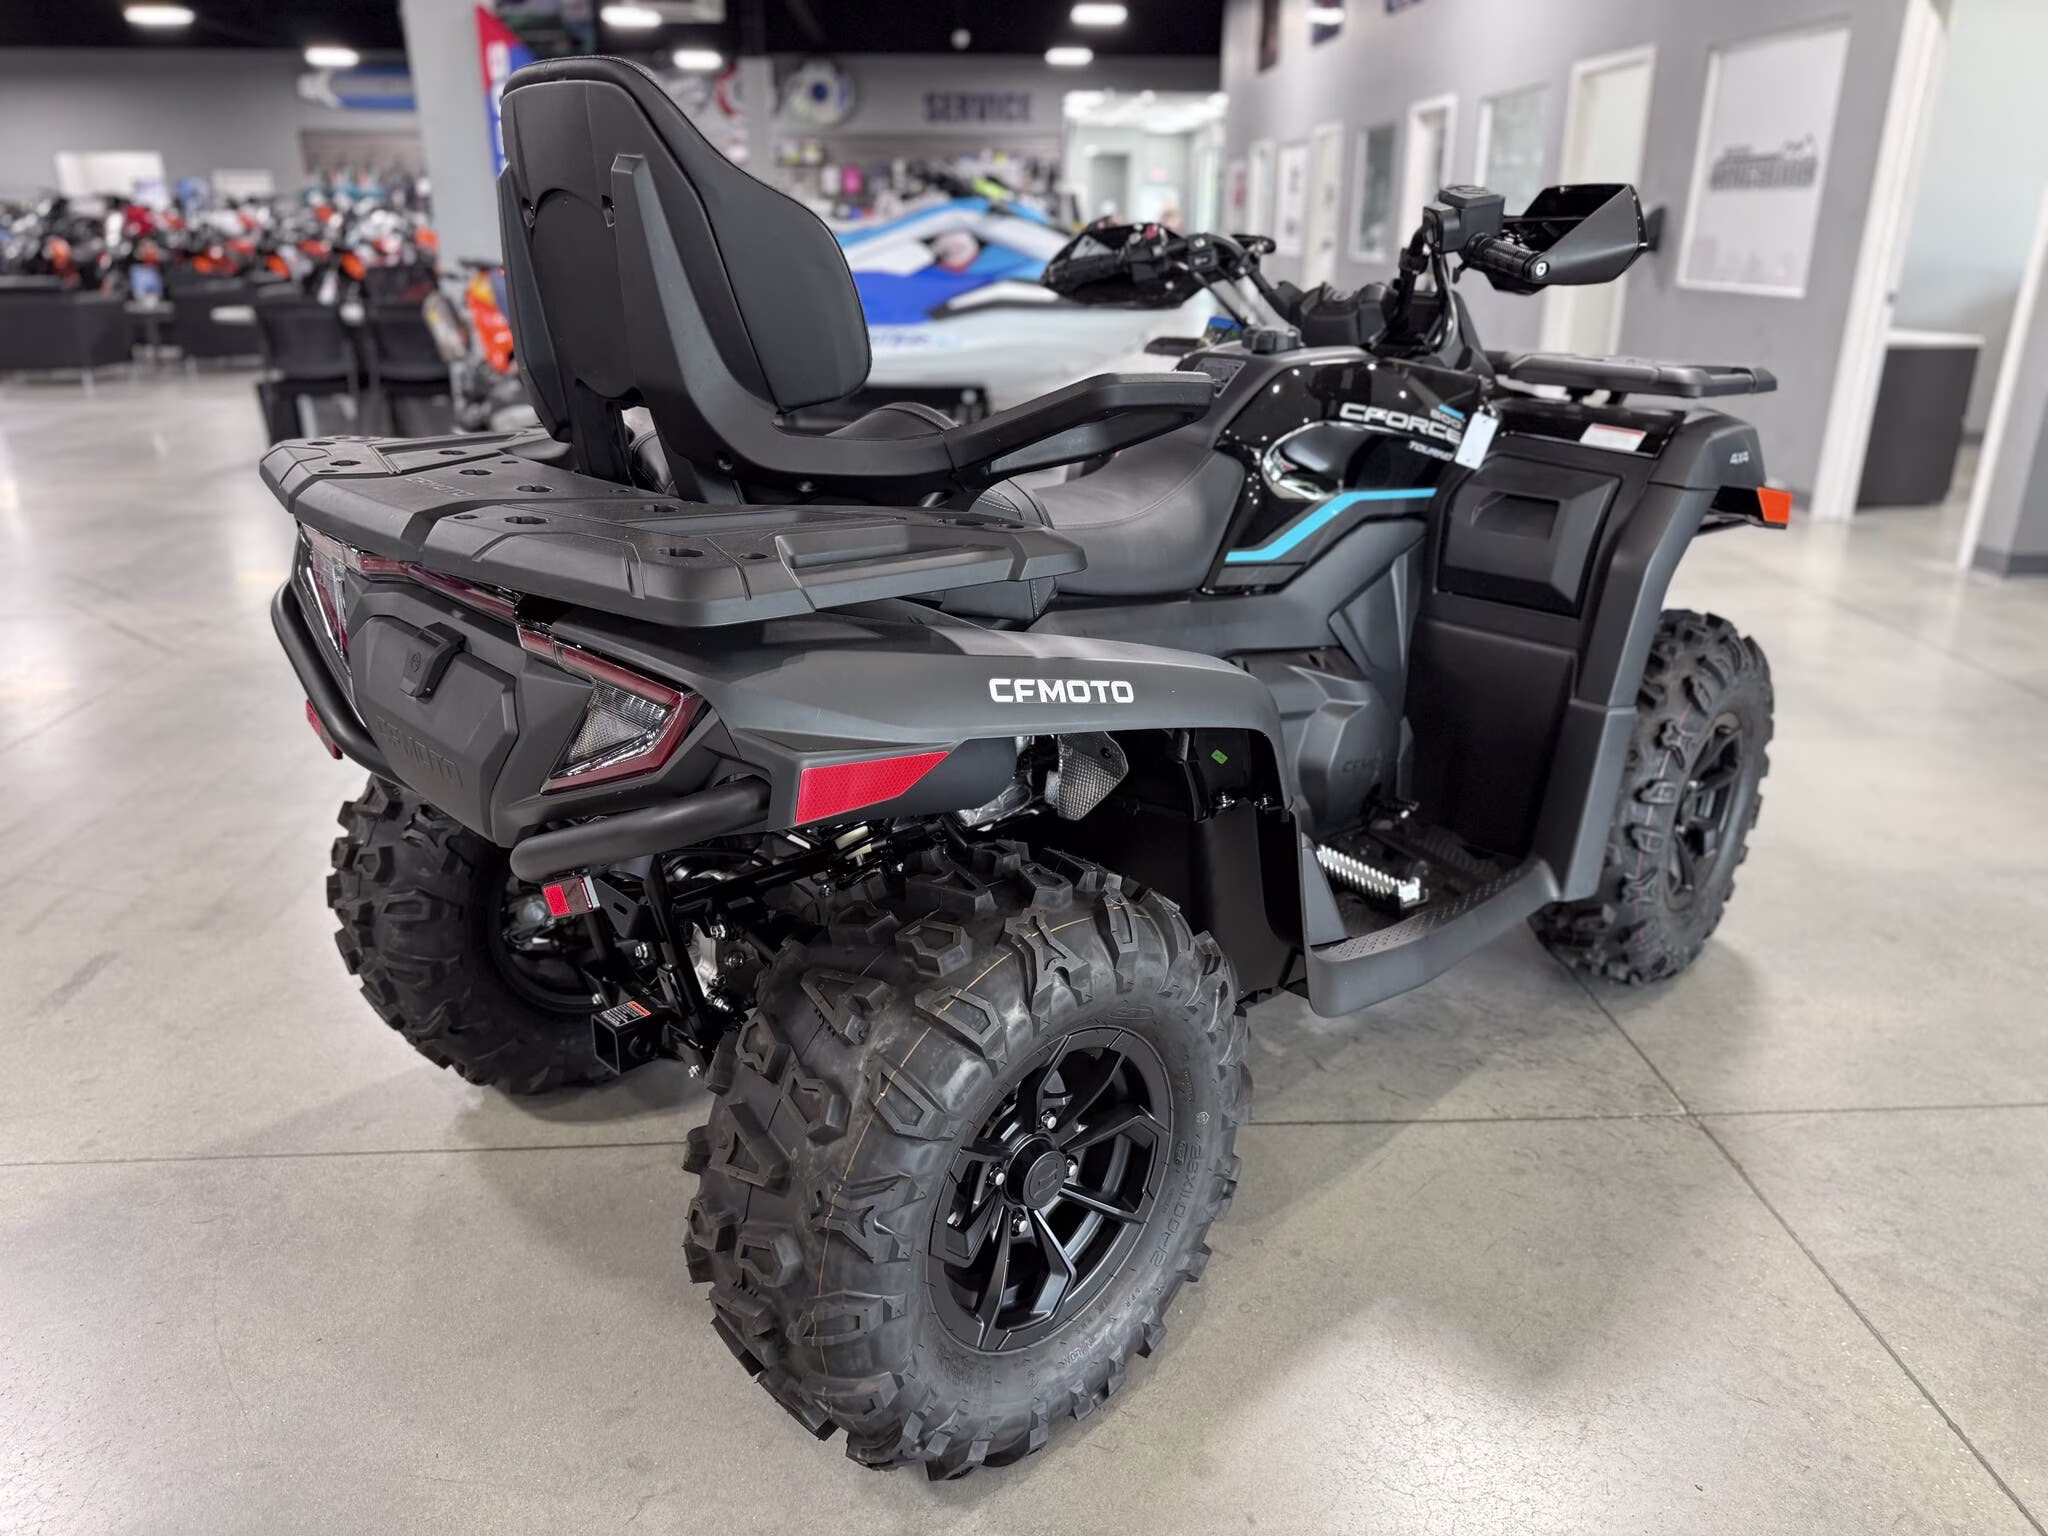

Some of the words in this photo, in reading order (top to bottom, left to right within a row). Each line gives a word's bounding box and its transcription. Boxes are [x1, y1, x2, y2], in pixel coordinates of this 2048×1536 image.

[924, 91, 1031, 122] SERVICE
[1339, 402, 1461, 445] CFORCE
[988, 678, 1135, 704] CFMOTO
